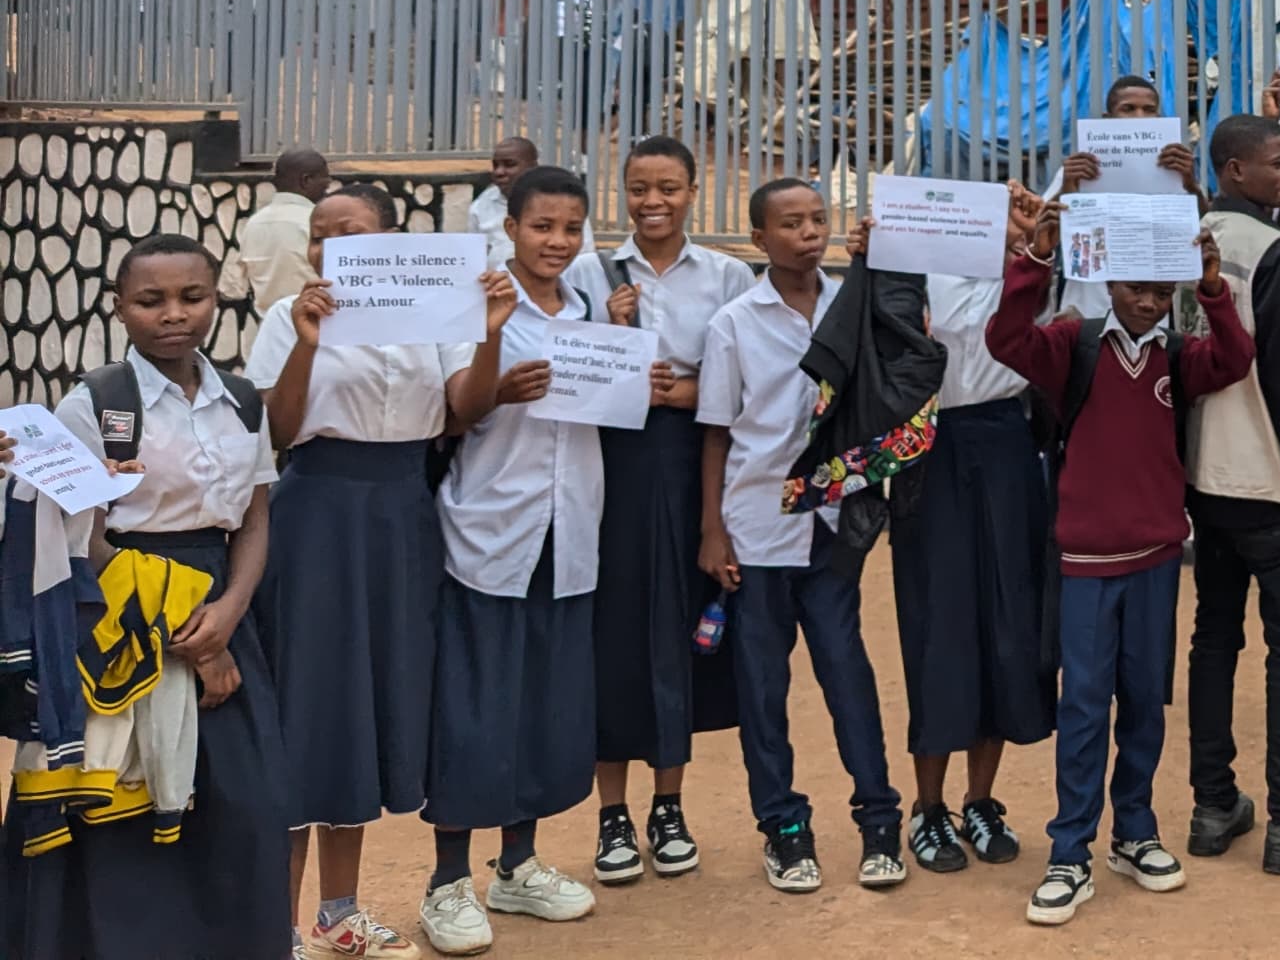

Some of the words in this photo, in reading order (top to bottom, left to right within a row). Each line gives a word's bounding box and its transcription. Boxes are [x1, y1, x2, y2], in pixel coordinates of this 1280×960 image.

[1133, 131, 1157, 140] VBG
[1111, 145, 1121, 154] de
[1124, 145, 1158, 156] Respect
[930, 216, 957, 224] violence
[338, 255, 391, 267] Brisons
[396, 254, 408, 266] le
[411, 254, 457, 266] silence
[338, 275, 373, 287] VBG
[391, 274, 454, 287] Violence,
[336, 298, 361, 311] pas
[364, 296, 416, 308] Amour
[629, 365, 641, 373] un
